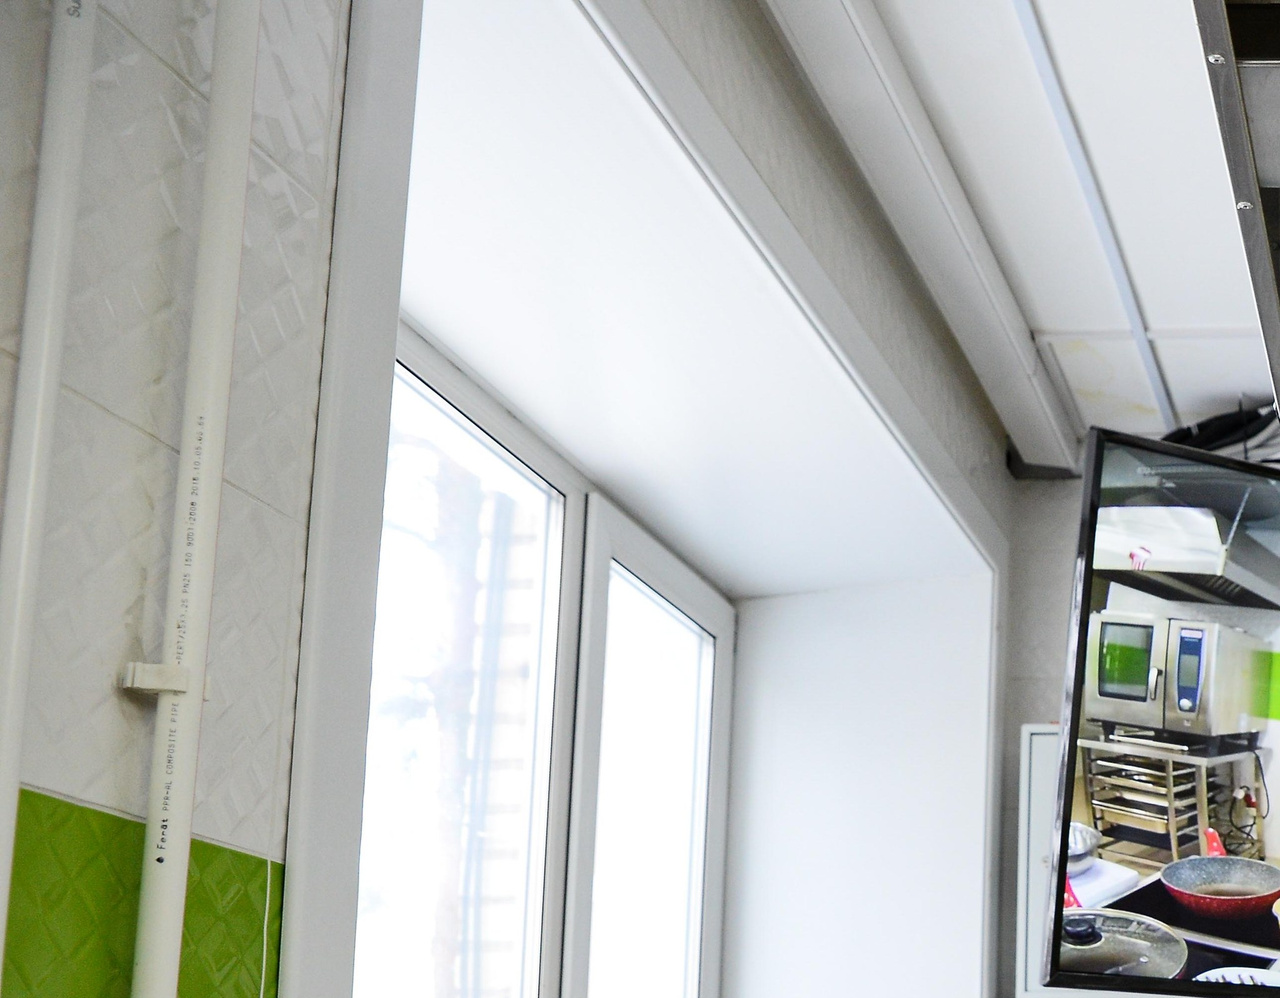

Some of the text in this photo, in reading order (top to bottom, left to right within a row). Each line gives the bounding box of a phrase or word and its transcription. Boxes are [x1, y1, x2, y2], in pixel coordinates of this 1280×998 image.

[67, 0, 82, 17] Su
[171, 702, 179, 722] PIPE
[166, 728, 176, 774] COMPOSITE
[163, 779, 172, 811] PPR-AL
